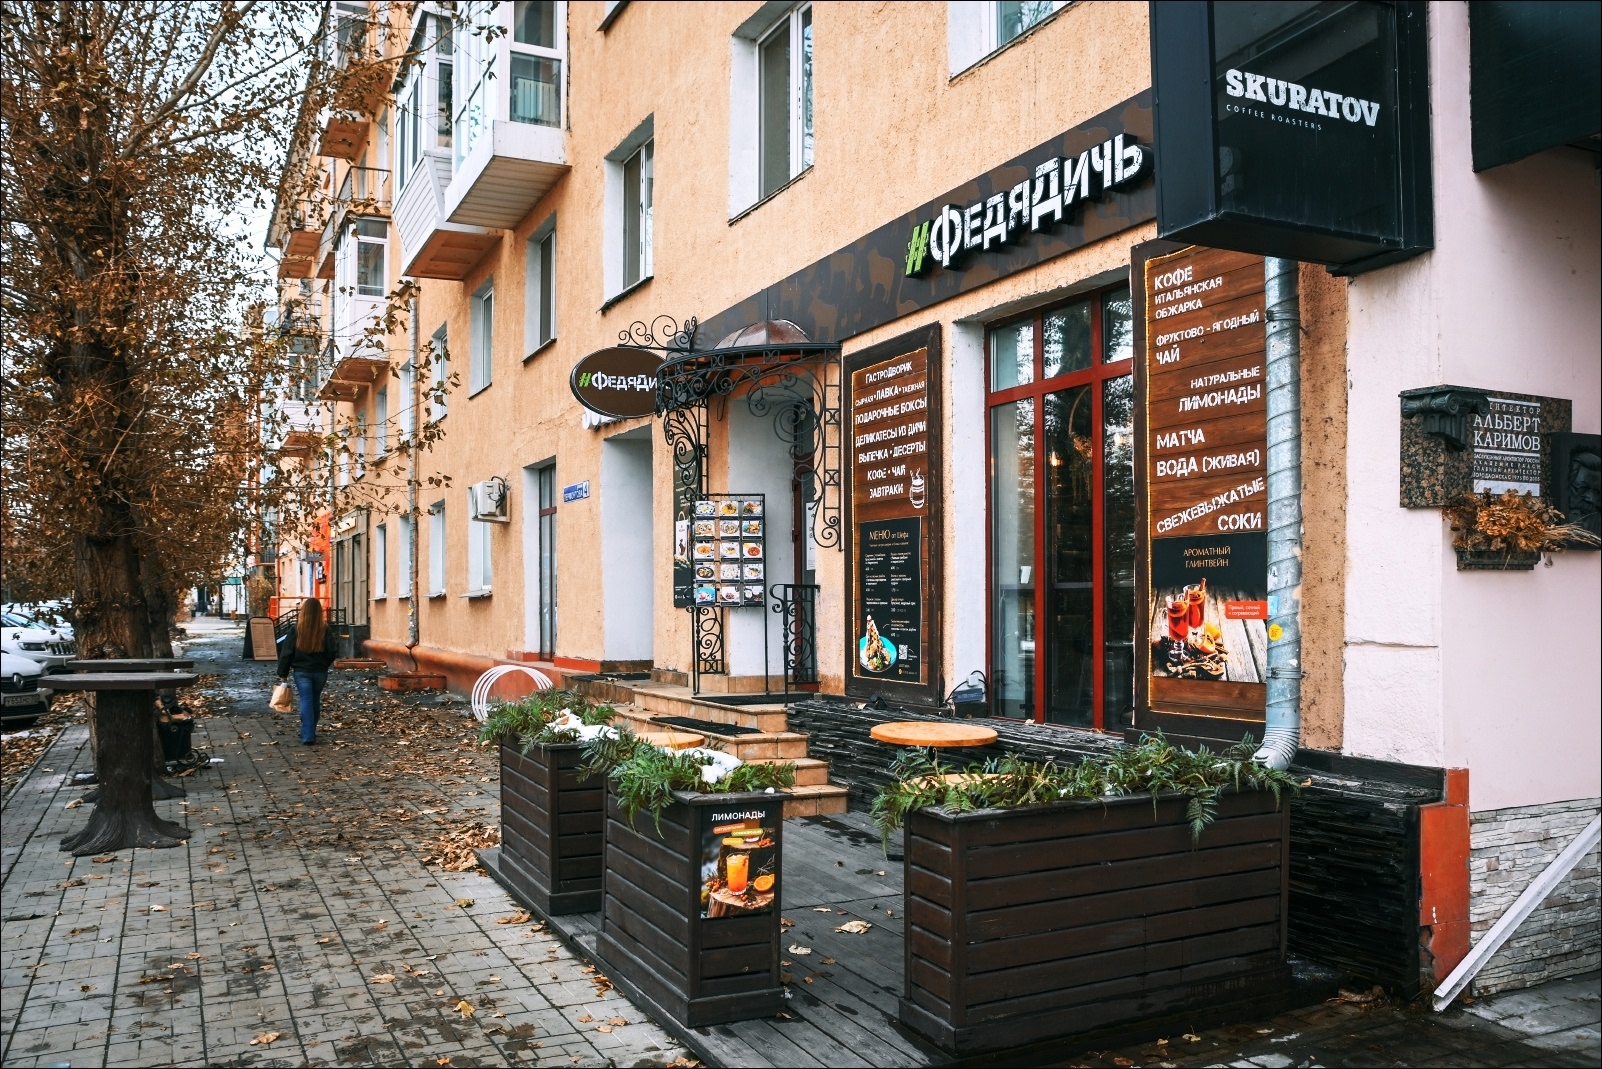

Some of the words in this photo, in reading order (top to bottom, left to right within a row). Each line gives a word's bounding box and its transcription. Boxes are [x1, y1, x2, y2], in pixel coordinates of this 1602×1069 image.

[1225, 68, 1380, 127] SKURATOV
[1226, 104, 1265, 119] COFFEE
[1271, 112, 1322, 131] ROASTERS
[1154, 266, 1193, 291] КОФЕ
[1154, 276, 1223, 305] ИТАЛЬЯНСКАЯ
[1155, 299, 1203, 320] ОБЖАРКА
[1156, 325, 1205, 347] ФРУКТОВО
[1212, 310, 1260, 333] ЯГОДНЫЙ
[1156, 345, 1180, 366] ЧАЙ
[1190, 366, 1261, 389] НАТУРАЛЬНЫЕ
[876, 386, 899, 401] ЛАВКА
[1178, 384, 1261, 413] ЛИМОНАДЫ
[855, 406, 900, 426] ПОДАРОЧНЫЕ
[900, 396, 927, 414] БОКСЫ
[1473, 413, 1541, 433] АЛЬБЕРТ
[855, 427, 898, 449] ДЕЛИКАТЕСЫ
[898, 425, 906, 438] ИЗ
[908, 420, 927, 437] ДИЧИ
[1156, 428, 1206, 450] МАТЧА
[1473, 430, 1541, 451] КАРИМОВ
[858, 448, 889, 464] ВЫПЕЧКА
[892, 440, 926, 458] ДЕСЕРТЫ
[867, 467, 887, 481] КОФЕ
[892, 464, 906, 477] ЧАЙ
[1156, 456, 1198, 478] ВОДА
[869, 483, 904, 499] ЗАВТРАКИ
[1156, 477, 1265, 534] СВЕЖЕВЫЖАТЫЕ
[1217, 511, 1262, 532] СОКИ
[868, 530, 890, 540] МЕНЮ
[1183, 546, 1231, 557] АРОМАТНЫЙ
[1185, 558, 1229, 568] ГЛИНТВЕЙН
[712, 810, 766, 822] ЛИМОНАДЫ
